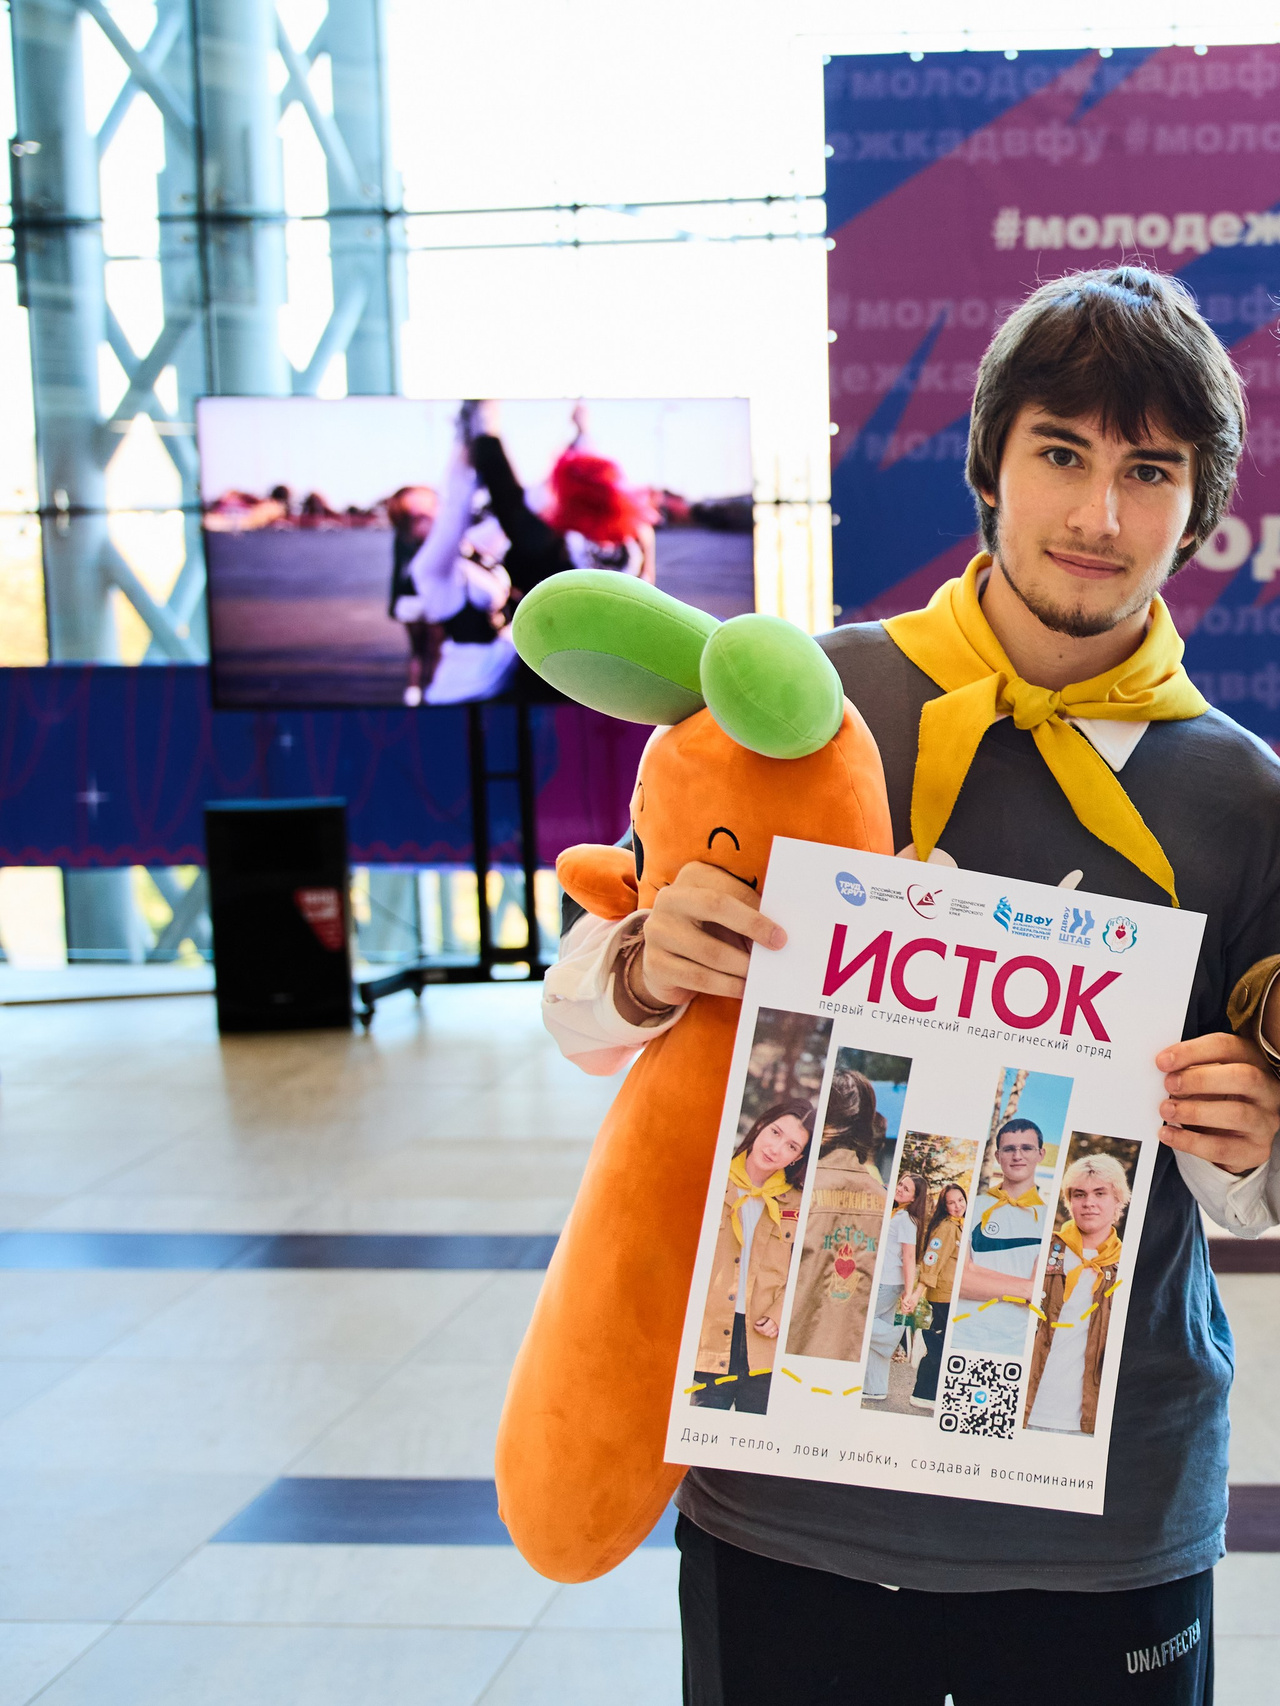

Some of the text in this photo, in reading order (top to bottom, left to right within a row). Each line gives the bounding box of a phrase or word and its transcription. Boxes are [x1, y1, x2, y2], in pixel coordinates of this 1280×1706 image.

[839, 880, 861, 890] ТРУД
[840, 887, 865, 898] КРУТ
[1014, 912, 1054, 927] ДВФУ
[1060, 906, 1071, 932] ДВФУ
[1059, 933, 1092, 946] ШТАБ
[821, 923, 1124, 1043] ИСТОК
[818, 999, 1113, 1060] первый студенческий педагогический отряд
[824, 1226, 876, 1252] ИСТОК
[680, 1427, 1095, 1491] Дари тепло, лови улыбки, создавай воспоминания
